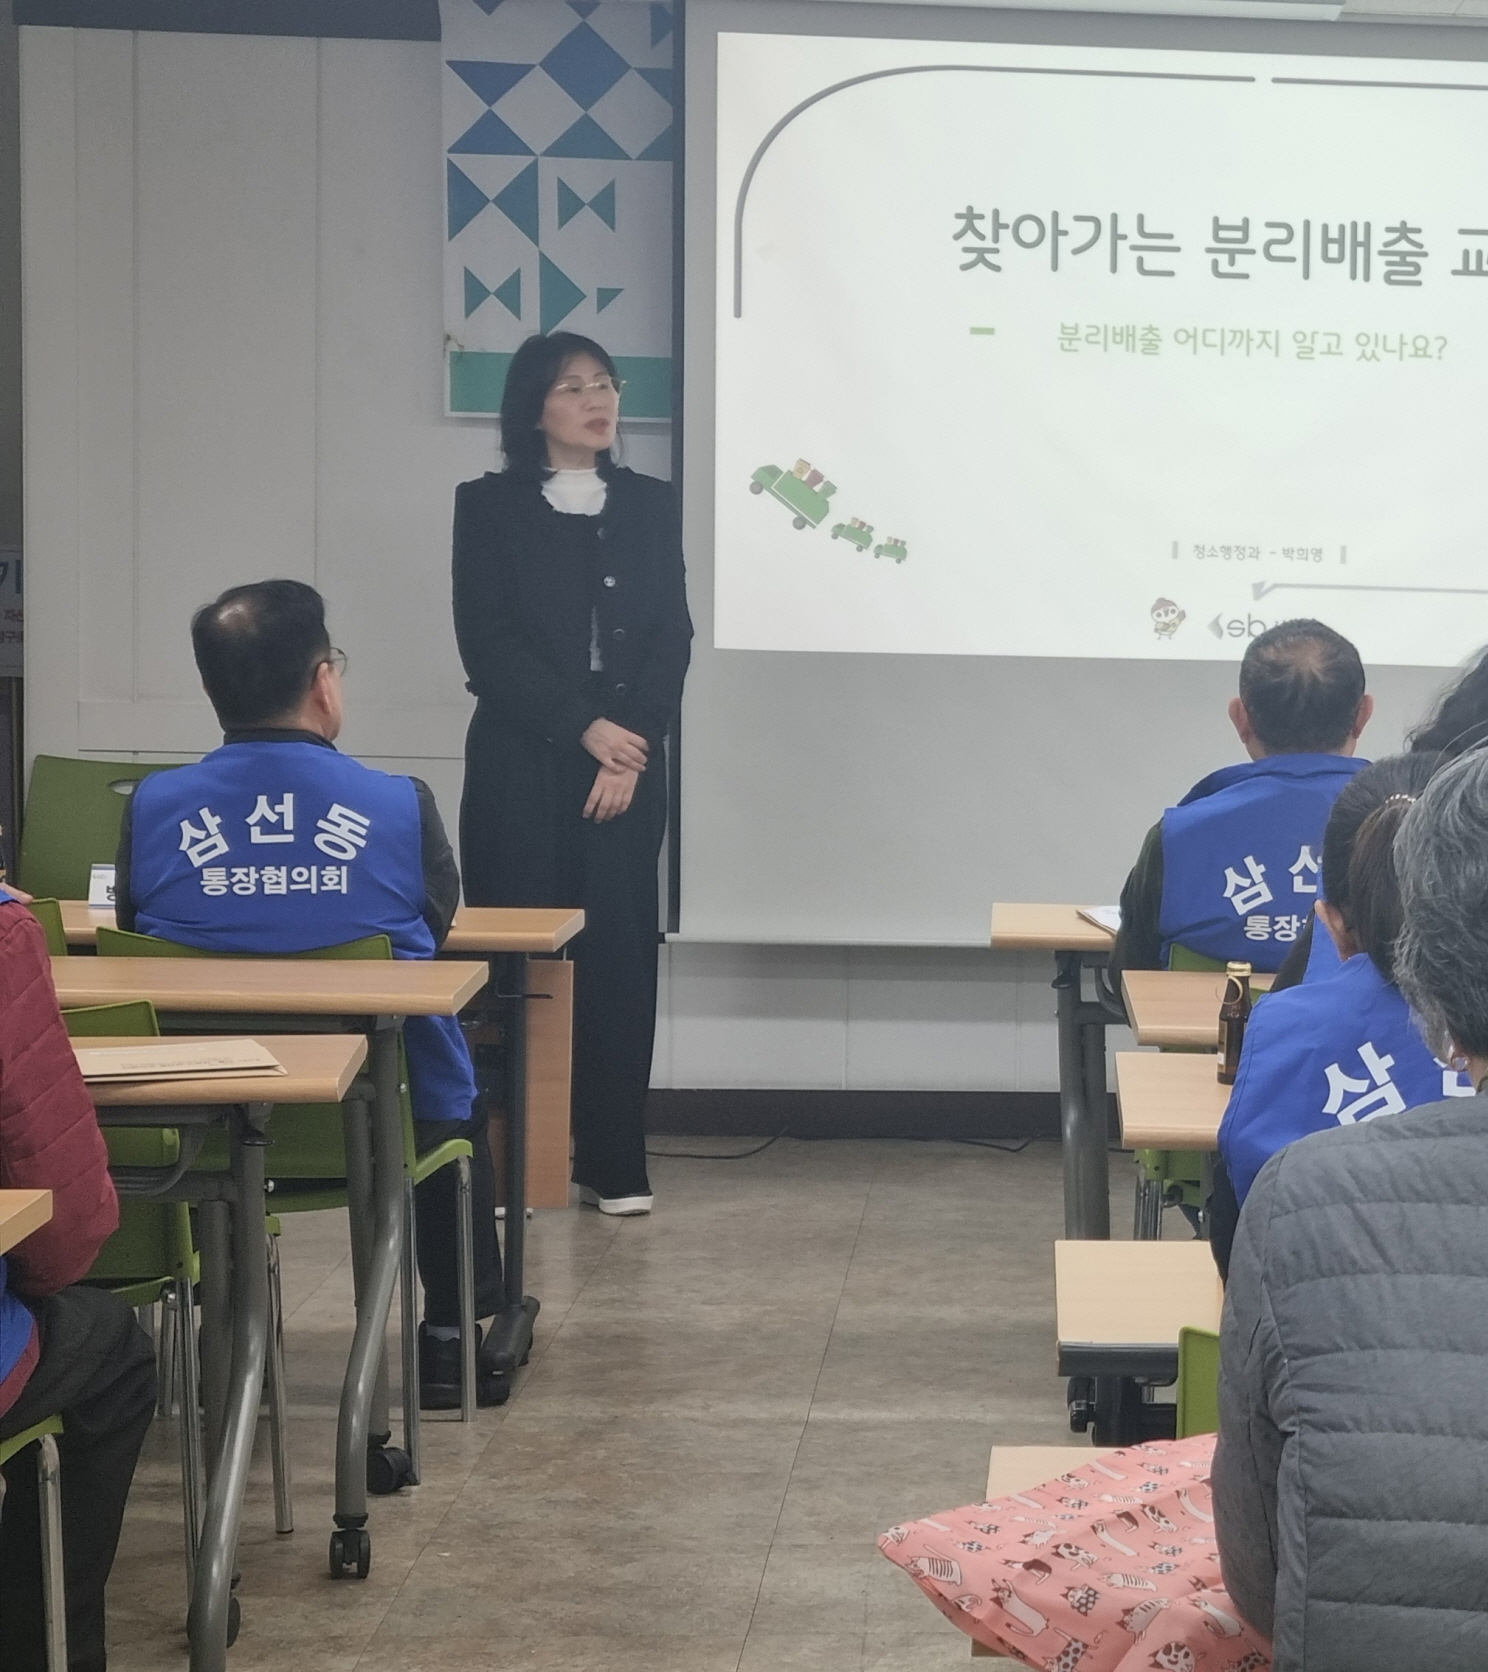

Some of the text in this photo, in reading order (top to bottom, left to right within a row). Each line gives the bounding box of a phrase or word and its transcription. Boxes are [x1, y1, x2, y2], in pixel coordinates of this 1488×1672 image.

[952, 204, 1182, 278] 찾아가는
[1204, 215, 1430, 287] 분리배출
[1057, 322, 1448, 363] 분리배출 어디까지 알고 있나요?
[1192, 544, 1261, 561] 청소행정과
[178, 792, 371, 868] 삼선동
[200, 865, 348, 896] 통장협의회
[1222, 845, 1322, 916] 삼선
[1243, 914, 1307, 942] 통장
